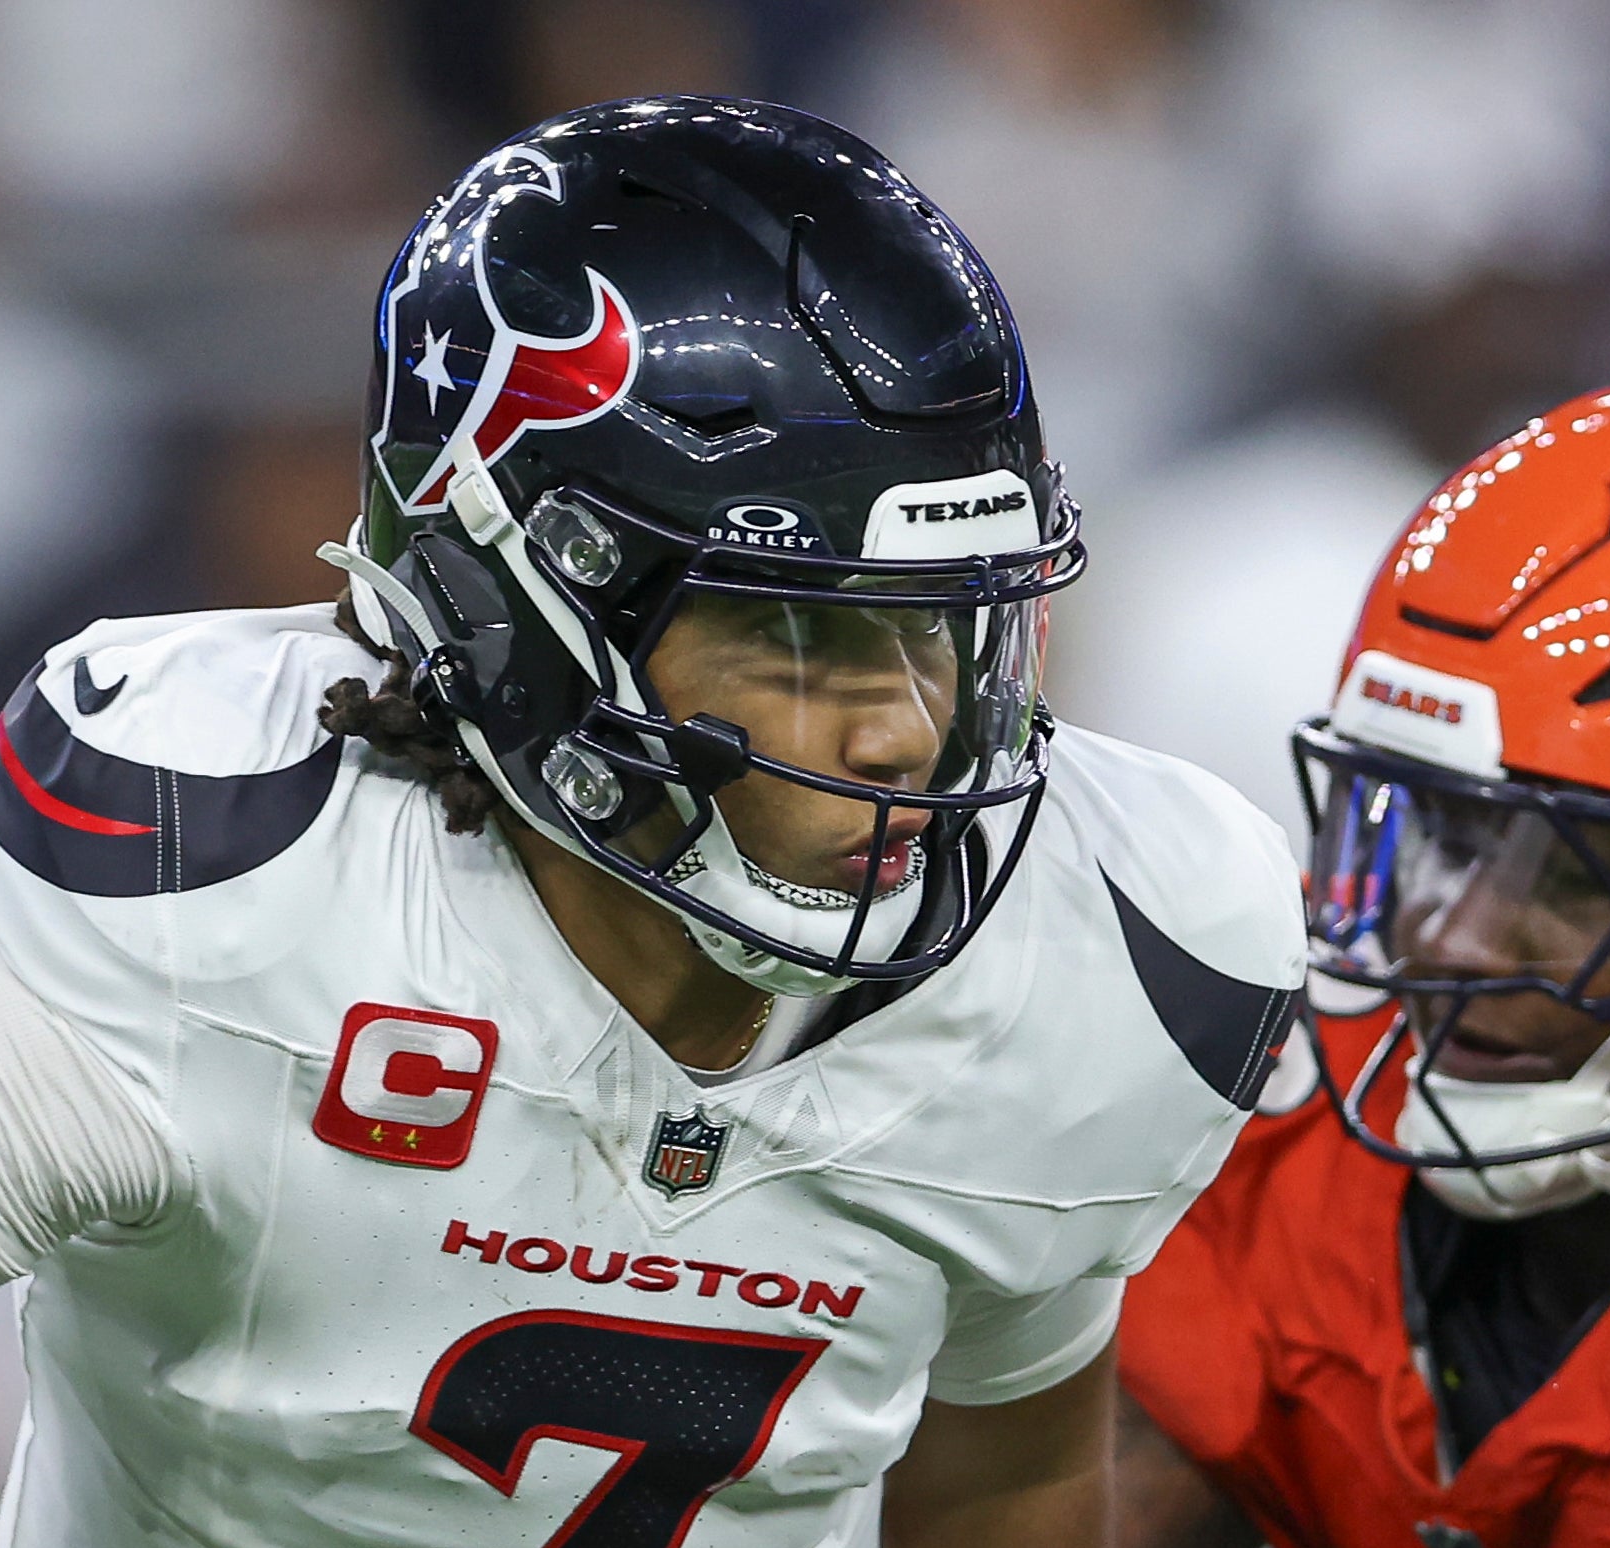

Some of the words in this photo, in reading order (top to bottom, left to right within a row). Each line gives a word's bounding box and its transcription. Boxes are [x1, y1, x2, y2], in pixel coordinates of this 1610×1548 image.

[898, 491, 1027, 523] TEXANS
[707, 526, 813, 549] OAKLEY
[339, 1018, 485, 1128] C
[653, 1147, 708, 1184] NFL
[440, 1219, 866, 1320] HOUSTON
